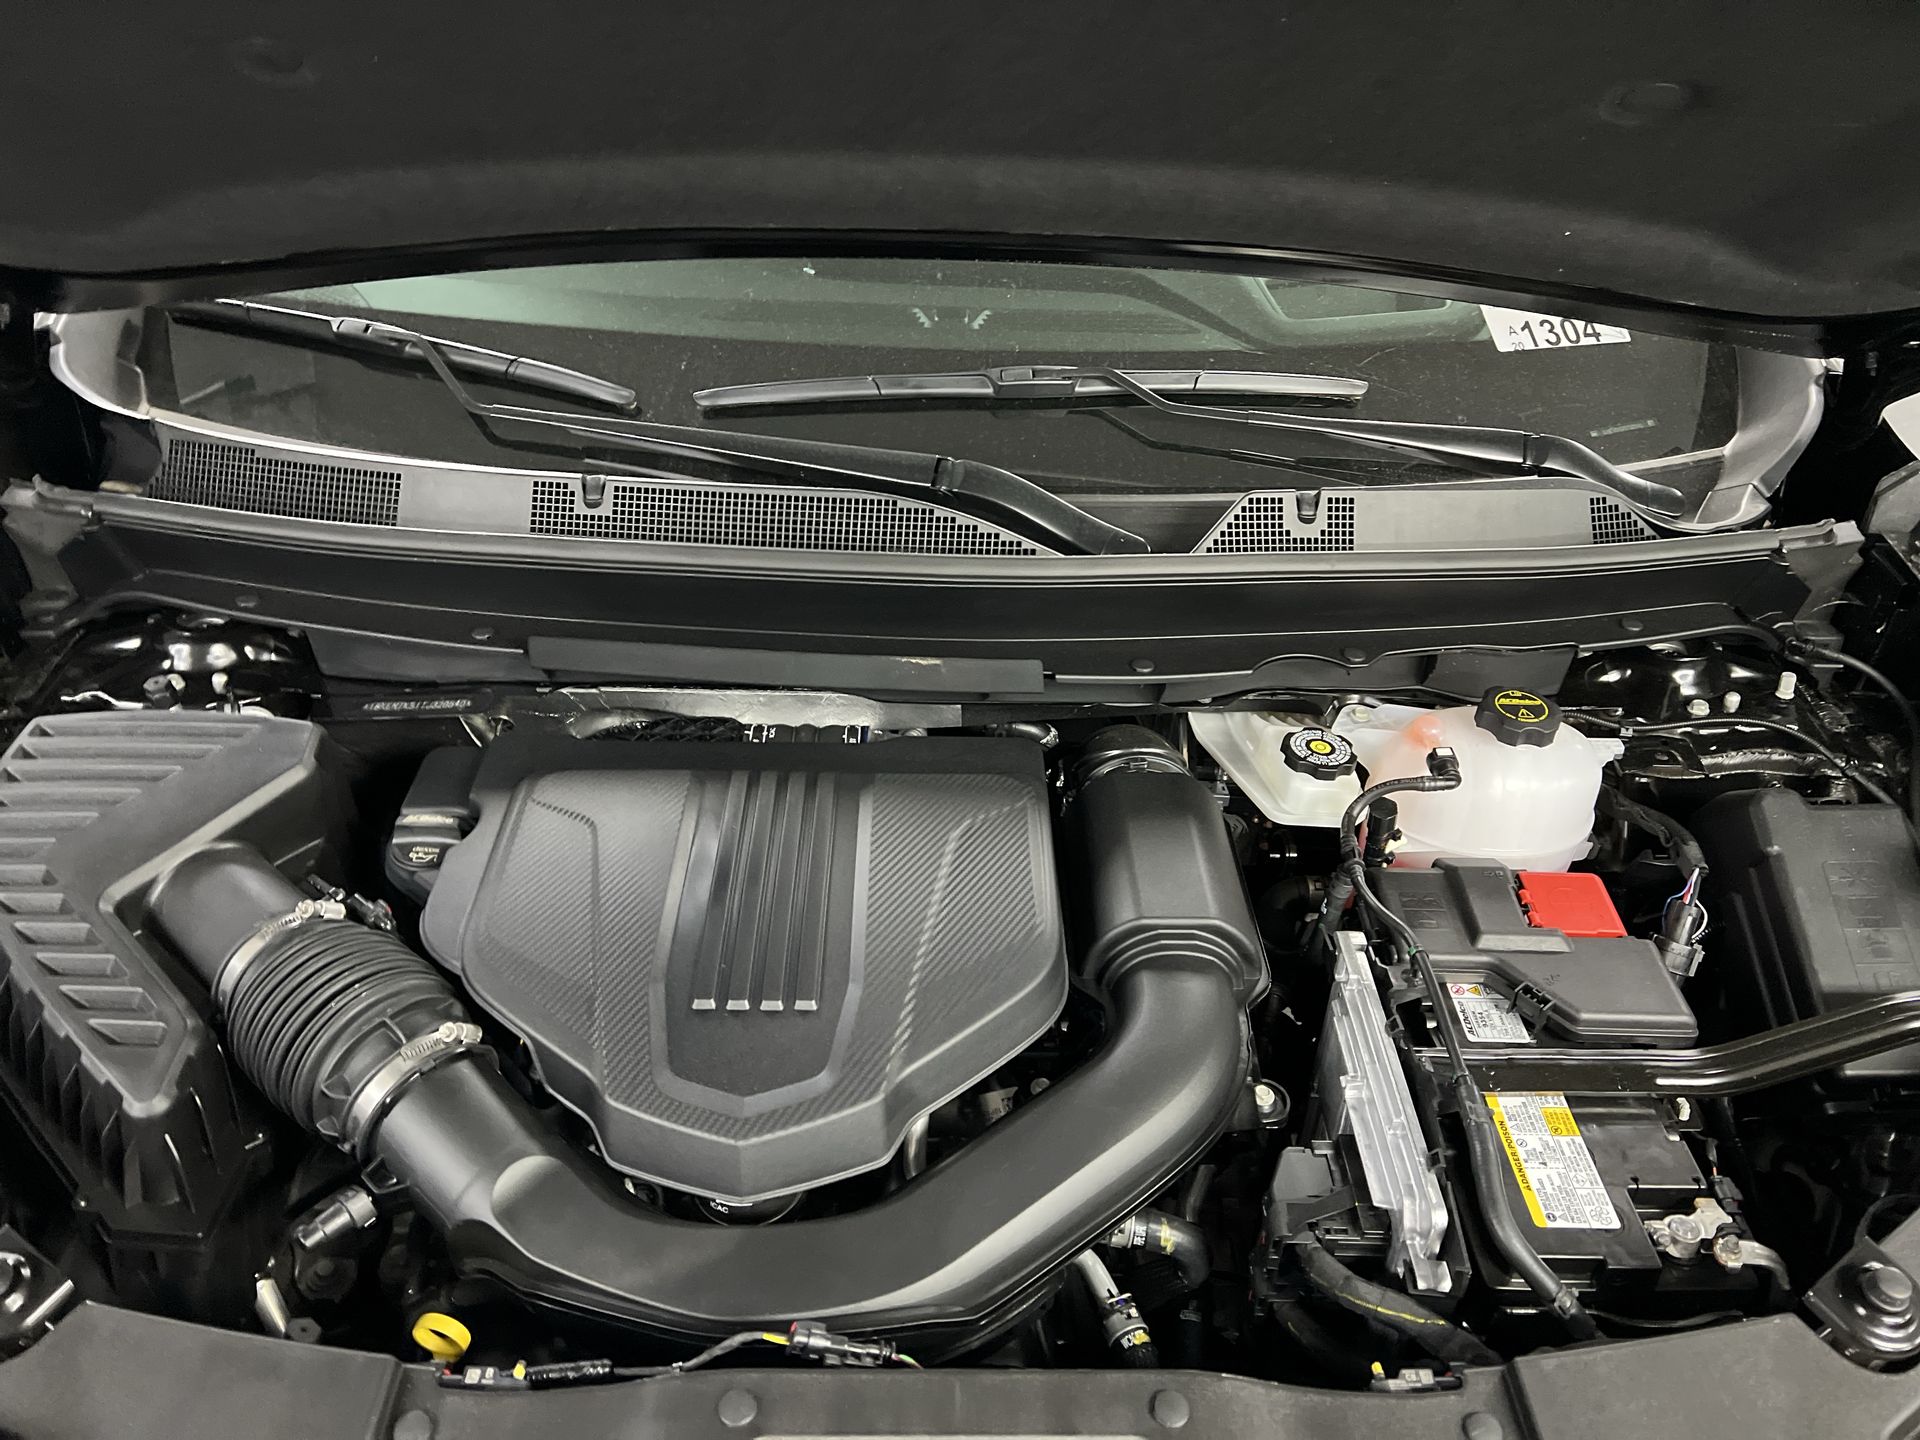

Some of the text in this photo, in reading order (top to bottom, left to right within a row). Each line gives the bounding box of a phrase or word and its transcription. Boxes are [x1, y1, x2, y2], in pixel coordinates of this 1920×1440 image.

[1509, 325, 1519, 336] A
[1520, 318, 1602, 347] 1304
[1458, 1000, 1477, 1036] ACDelco
